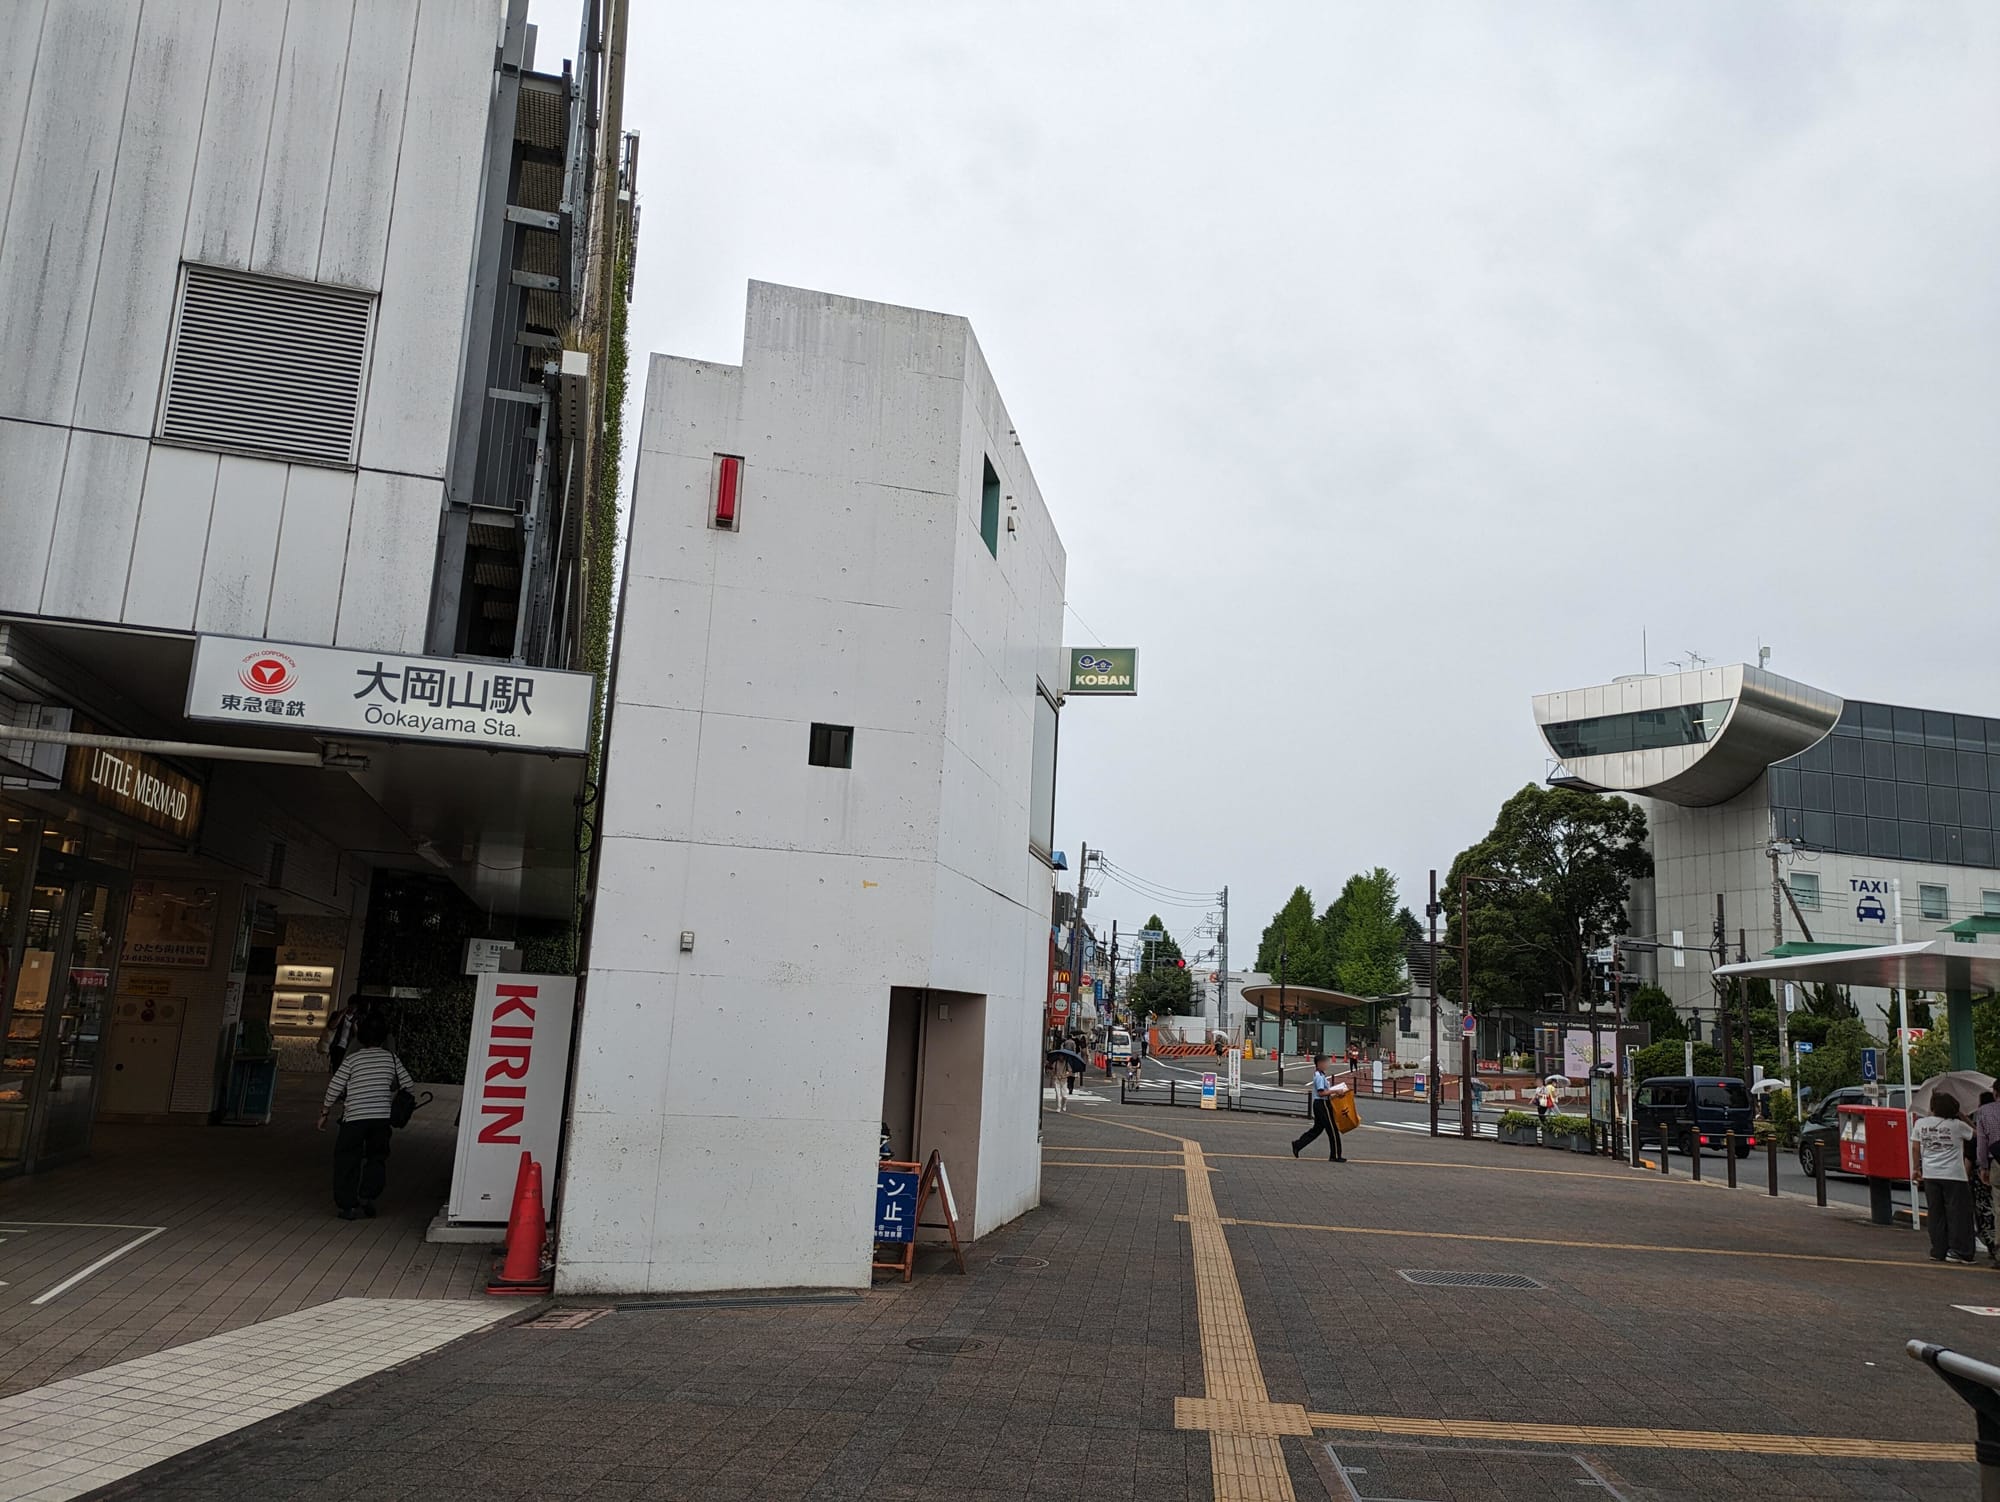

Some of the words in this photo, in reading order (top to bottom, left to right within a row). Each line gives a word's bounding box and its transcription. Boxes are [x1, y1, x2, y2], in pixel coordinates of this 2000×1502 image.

[242, 651, 260, 664] TOKYU
[261, 650, 297, 668] CORPORATION
[353, 661, 535, 717] 大岡山駅
[1075, 674, 1130, 686] KOBAN
[219, 693, 307, 718] 東急電鉄
[482, 717, 521, 738] Sta.
[90, 748, 133, 798] LITTLE
[132, 769, 188, 822] MERMAID
[1849, 879, 1888, 894] TAXI
[477, 983, 539, 1145] KIRIN
[883, 1200, 903, 1221] 止
